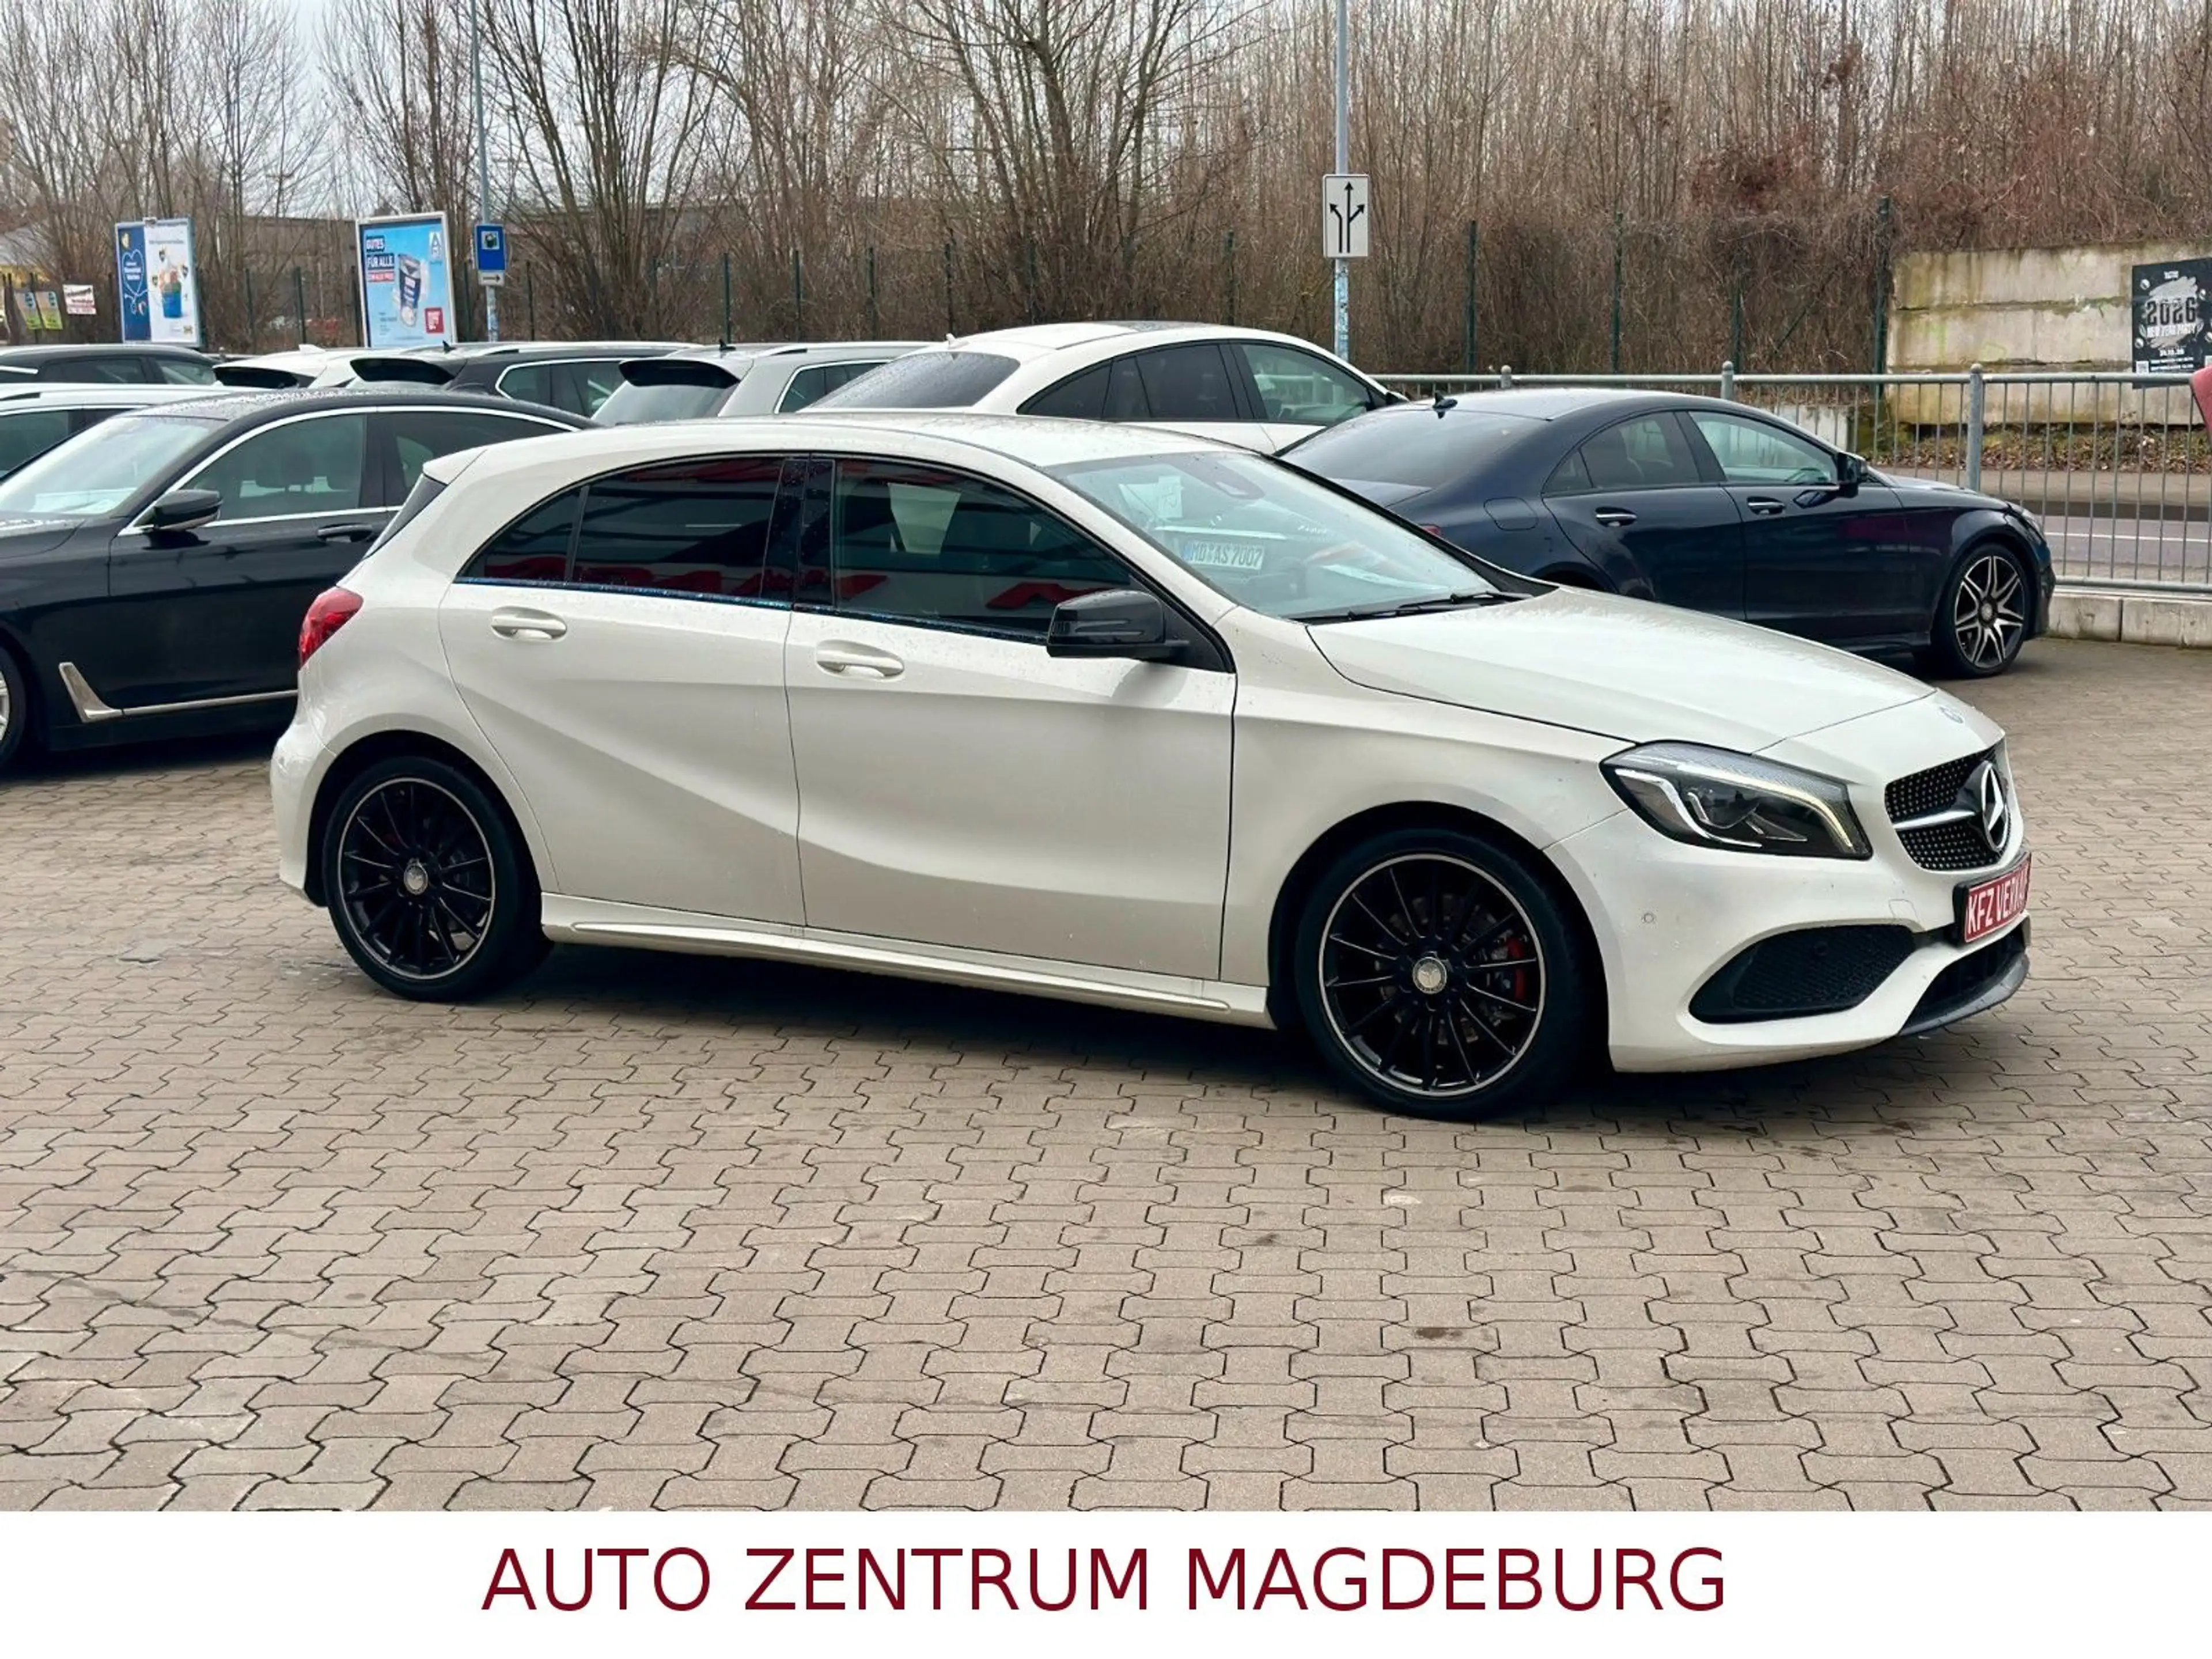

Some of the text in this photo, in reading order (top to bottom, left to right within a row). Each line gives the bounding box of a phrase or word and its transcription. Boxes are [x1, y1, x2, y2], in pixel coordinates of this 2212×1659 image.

[2147, 297, 2196, 326] 2026
[1231, 545, 1263, 567] 7007
[1968, 888, 1994, 934] KFZ
